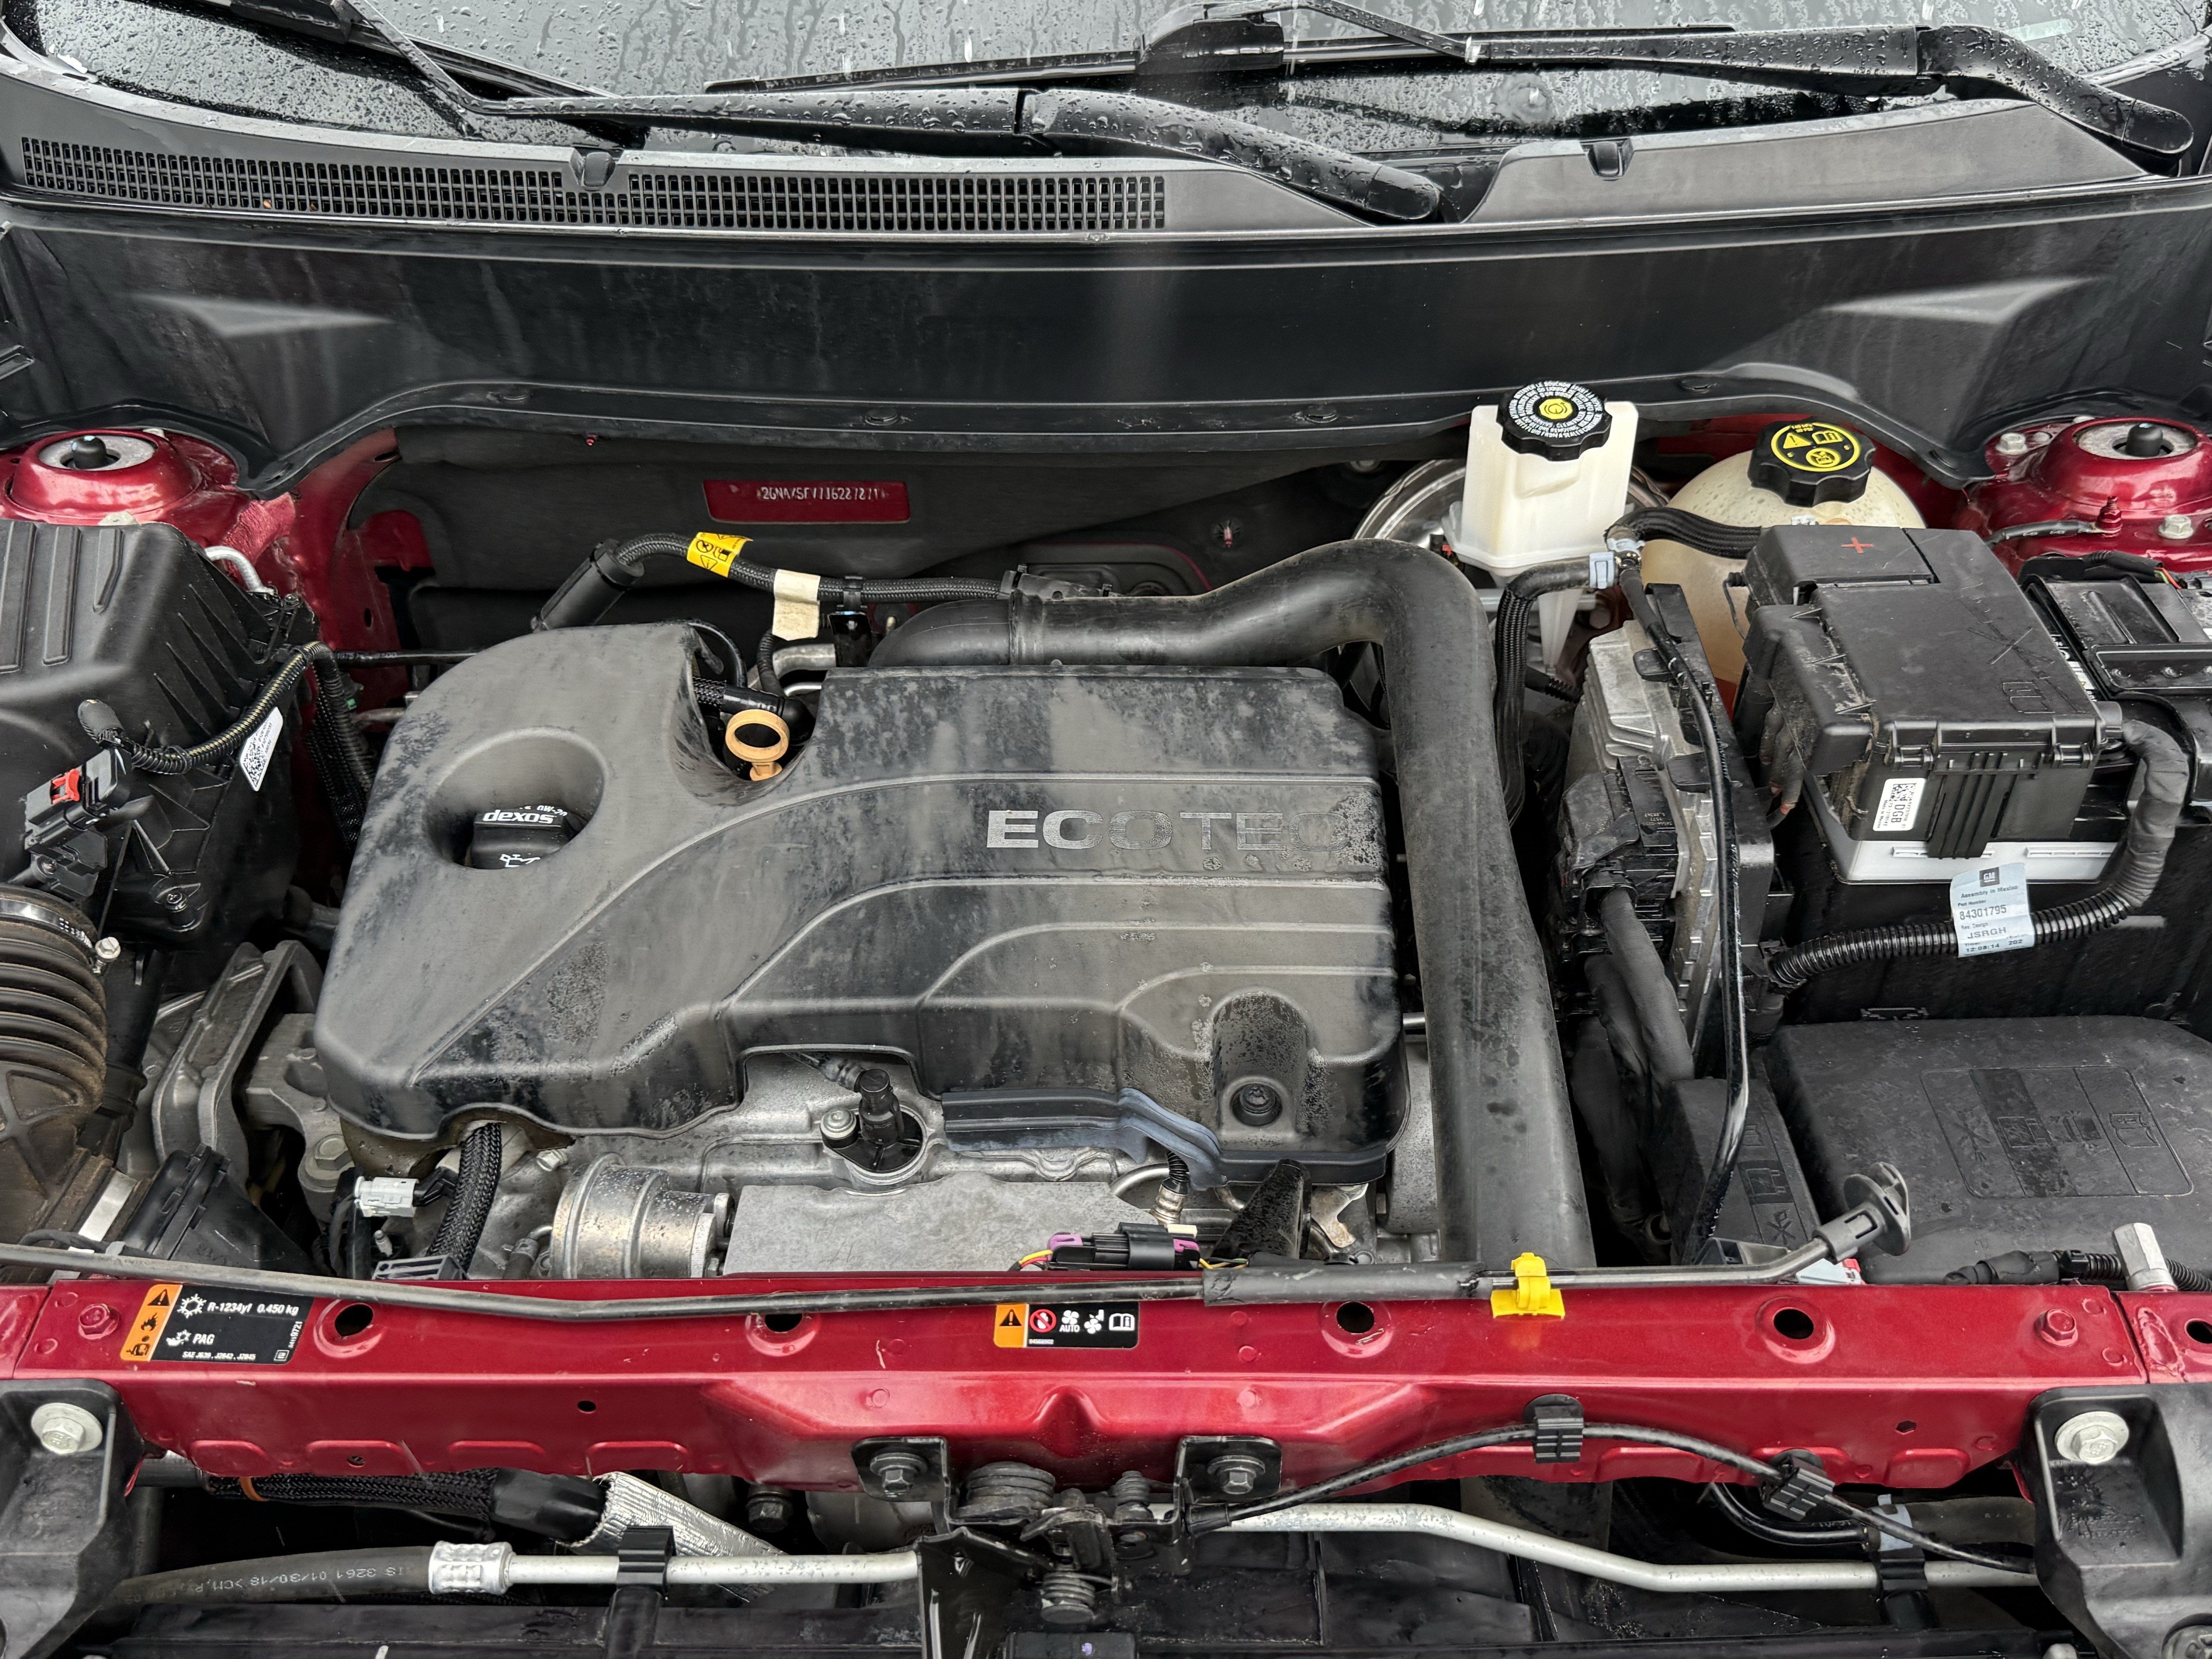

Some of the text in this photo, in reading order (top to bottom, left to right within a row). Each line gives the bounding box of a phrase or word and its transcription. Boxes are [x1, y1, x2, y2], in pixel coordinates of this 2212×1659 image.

[483, 809, 557, 824] dexos
[1891, 805, 1905, 823] DGB
[986, 810, 1350, 852] ECOTEC
[1983, 872, 1996, 880] GM
[1961, 890, 1988, 898] Assembly
[1960, 904, 2007, 920] 84301795
[207, 1302, 299, 1316] R-1234yf 0.450 kg
[1059, 1324, 1080, 1333] AUTO
[192, 1334, 215, 1345] PAG
[337, 1568, 376, 1579] 3261
